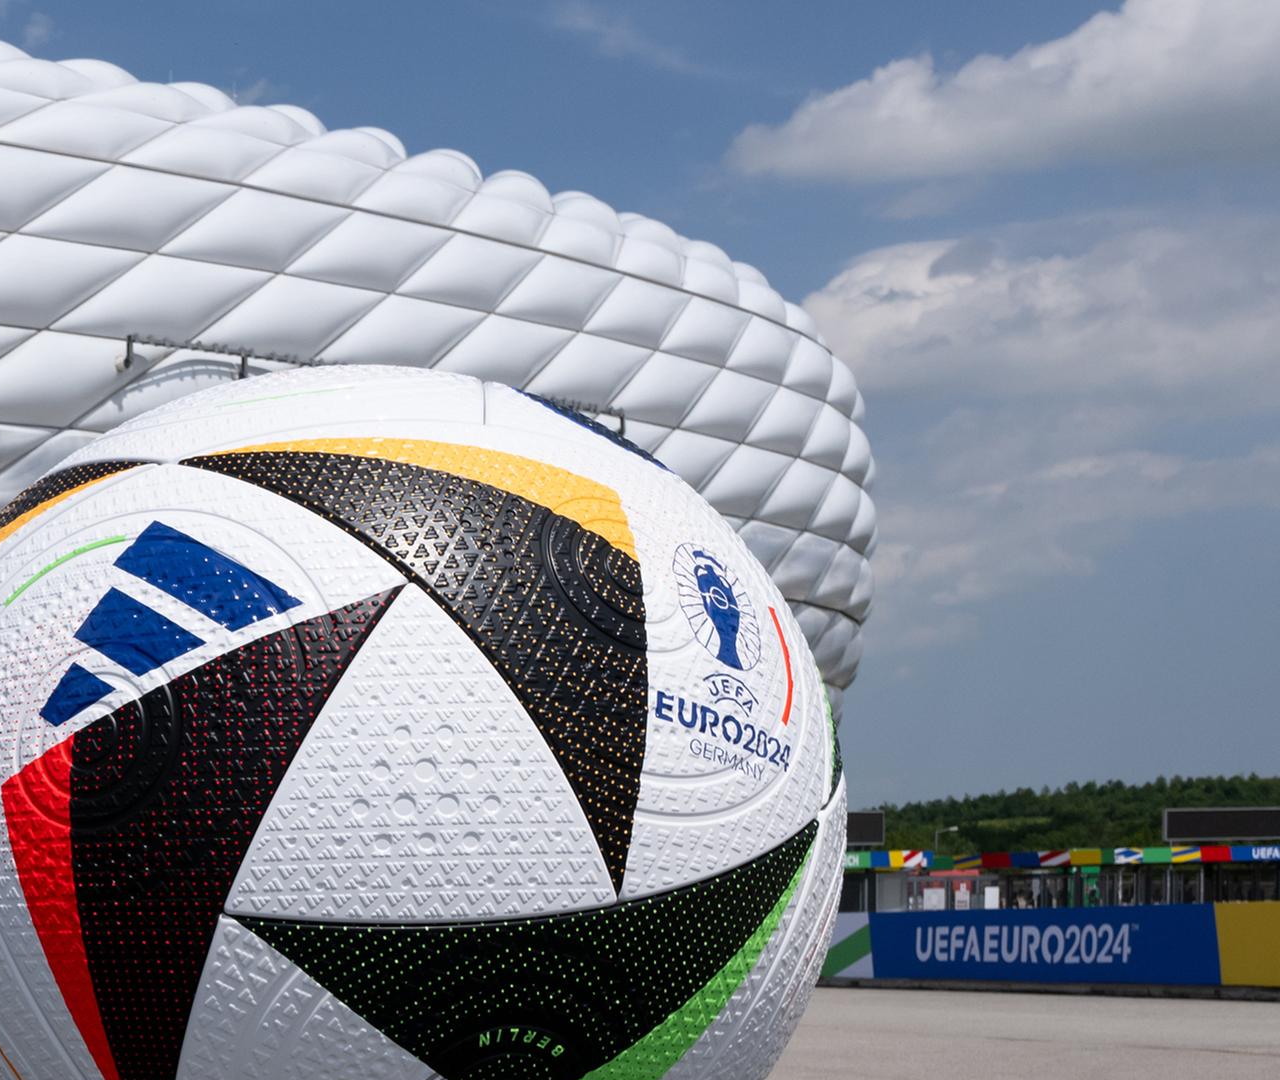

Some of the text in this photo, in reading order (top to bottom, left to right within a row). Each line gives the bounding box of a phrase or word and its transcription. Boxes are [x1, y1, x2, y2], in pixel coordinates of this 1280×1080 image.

[654, 690, 791, 772] EURO2024
[690, 738, 766, 781] GERMANY
[479, 1028, 565, 1057] BERLIN
